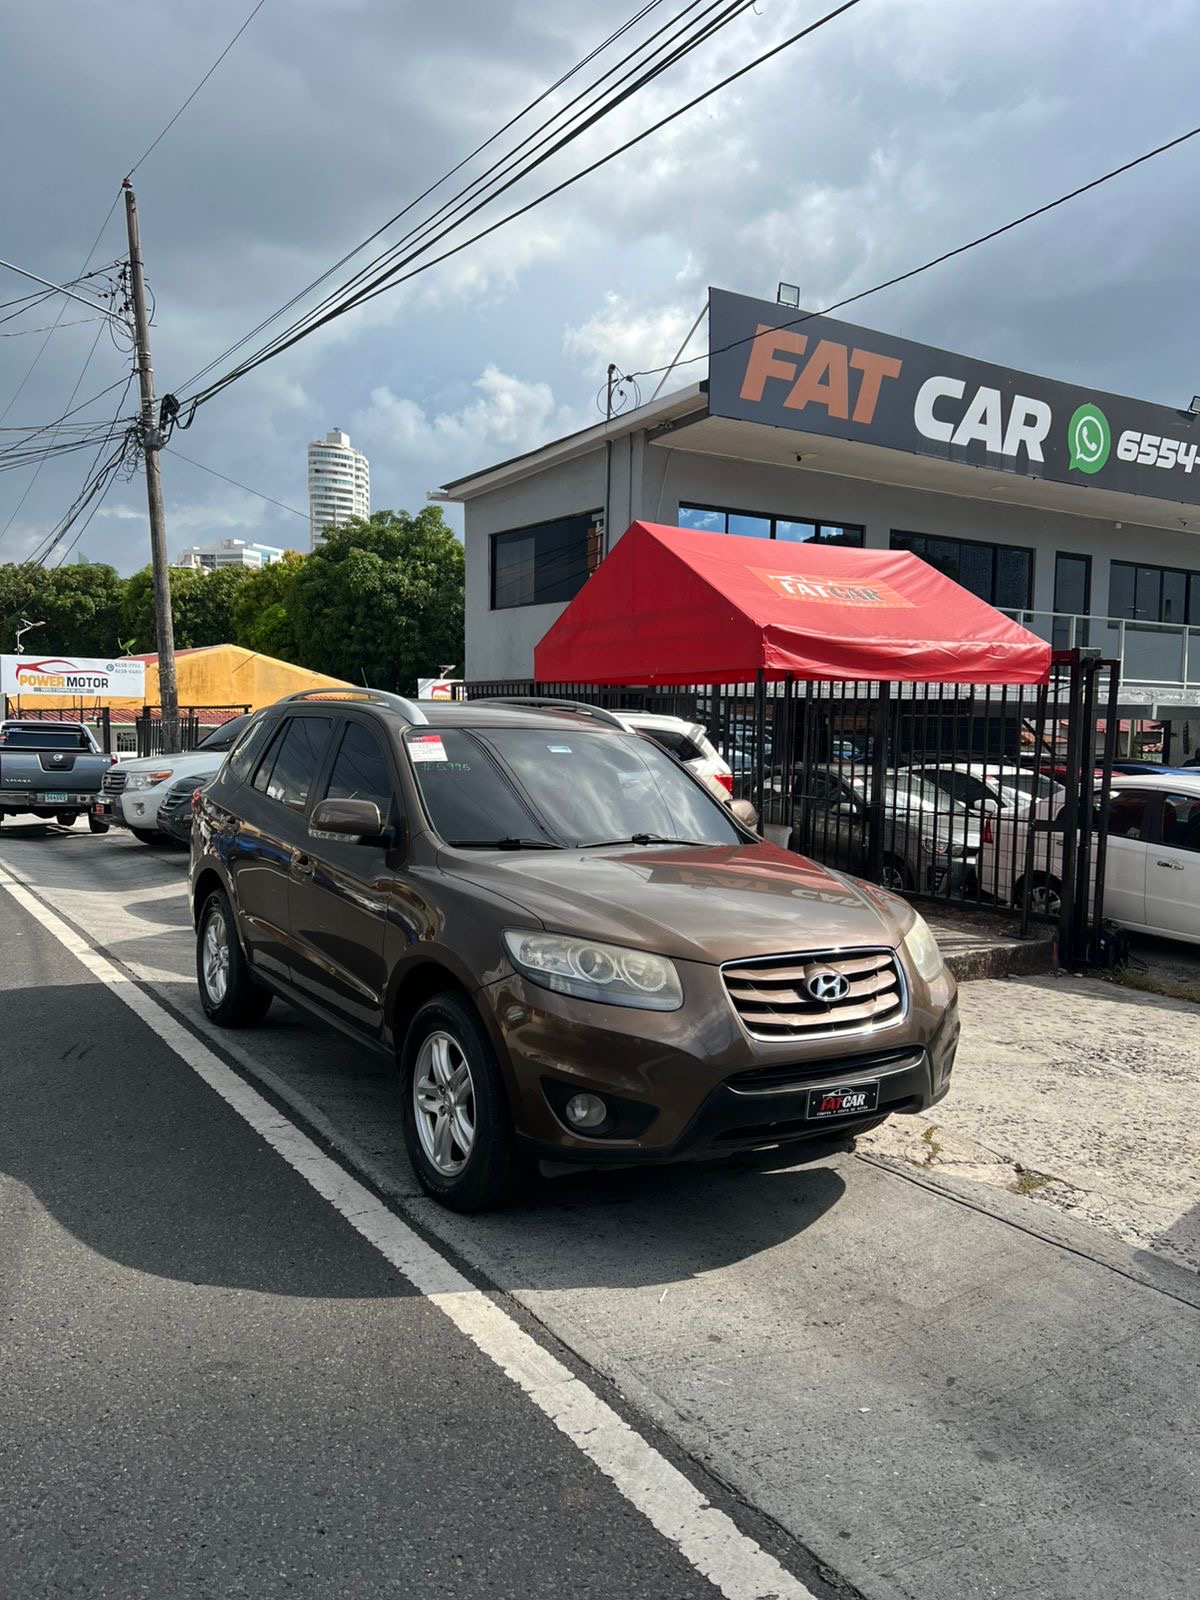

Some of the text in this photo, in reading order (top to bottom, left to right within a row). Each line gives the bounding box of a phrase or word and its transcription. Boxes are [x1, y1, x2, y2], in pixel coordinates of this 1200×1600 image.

[740, 324, 902, 424] FAT
[913, 376, 1052, 462] CAR
[20, 674, 109, 689] POWER MOTOR
